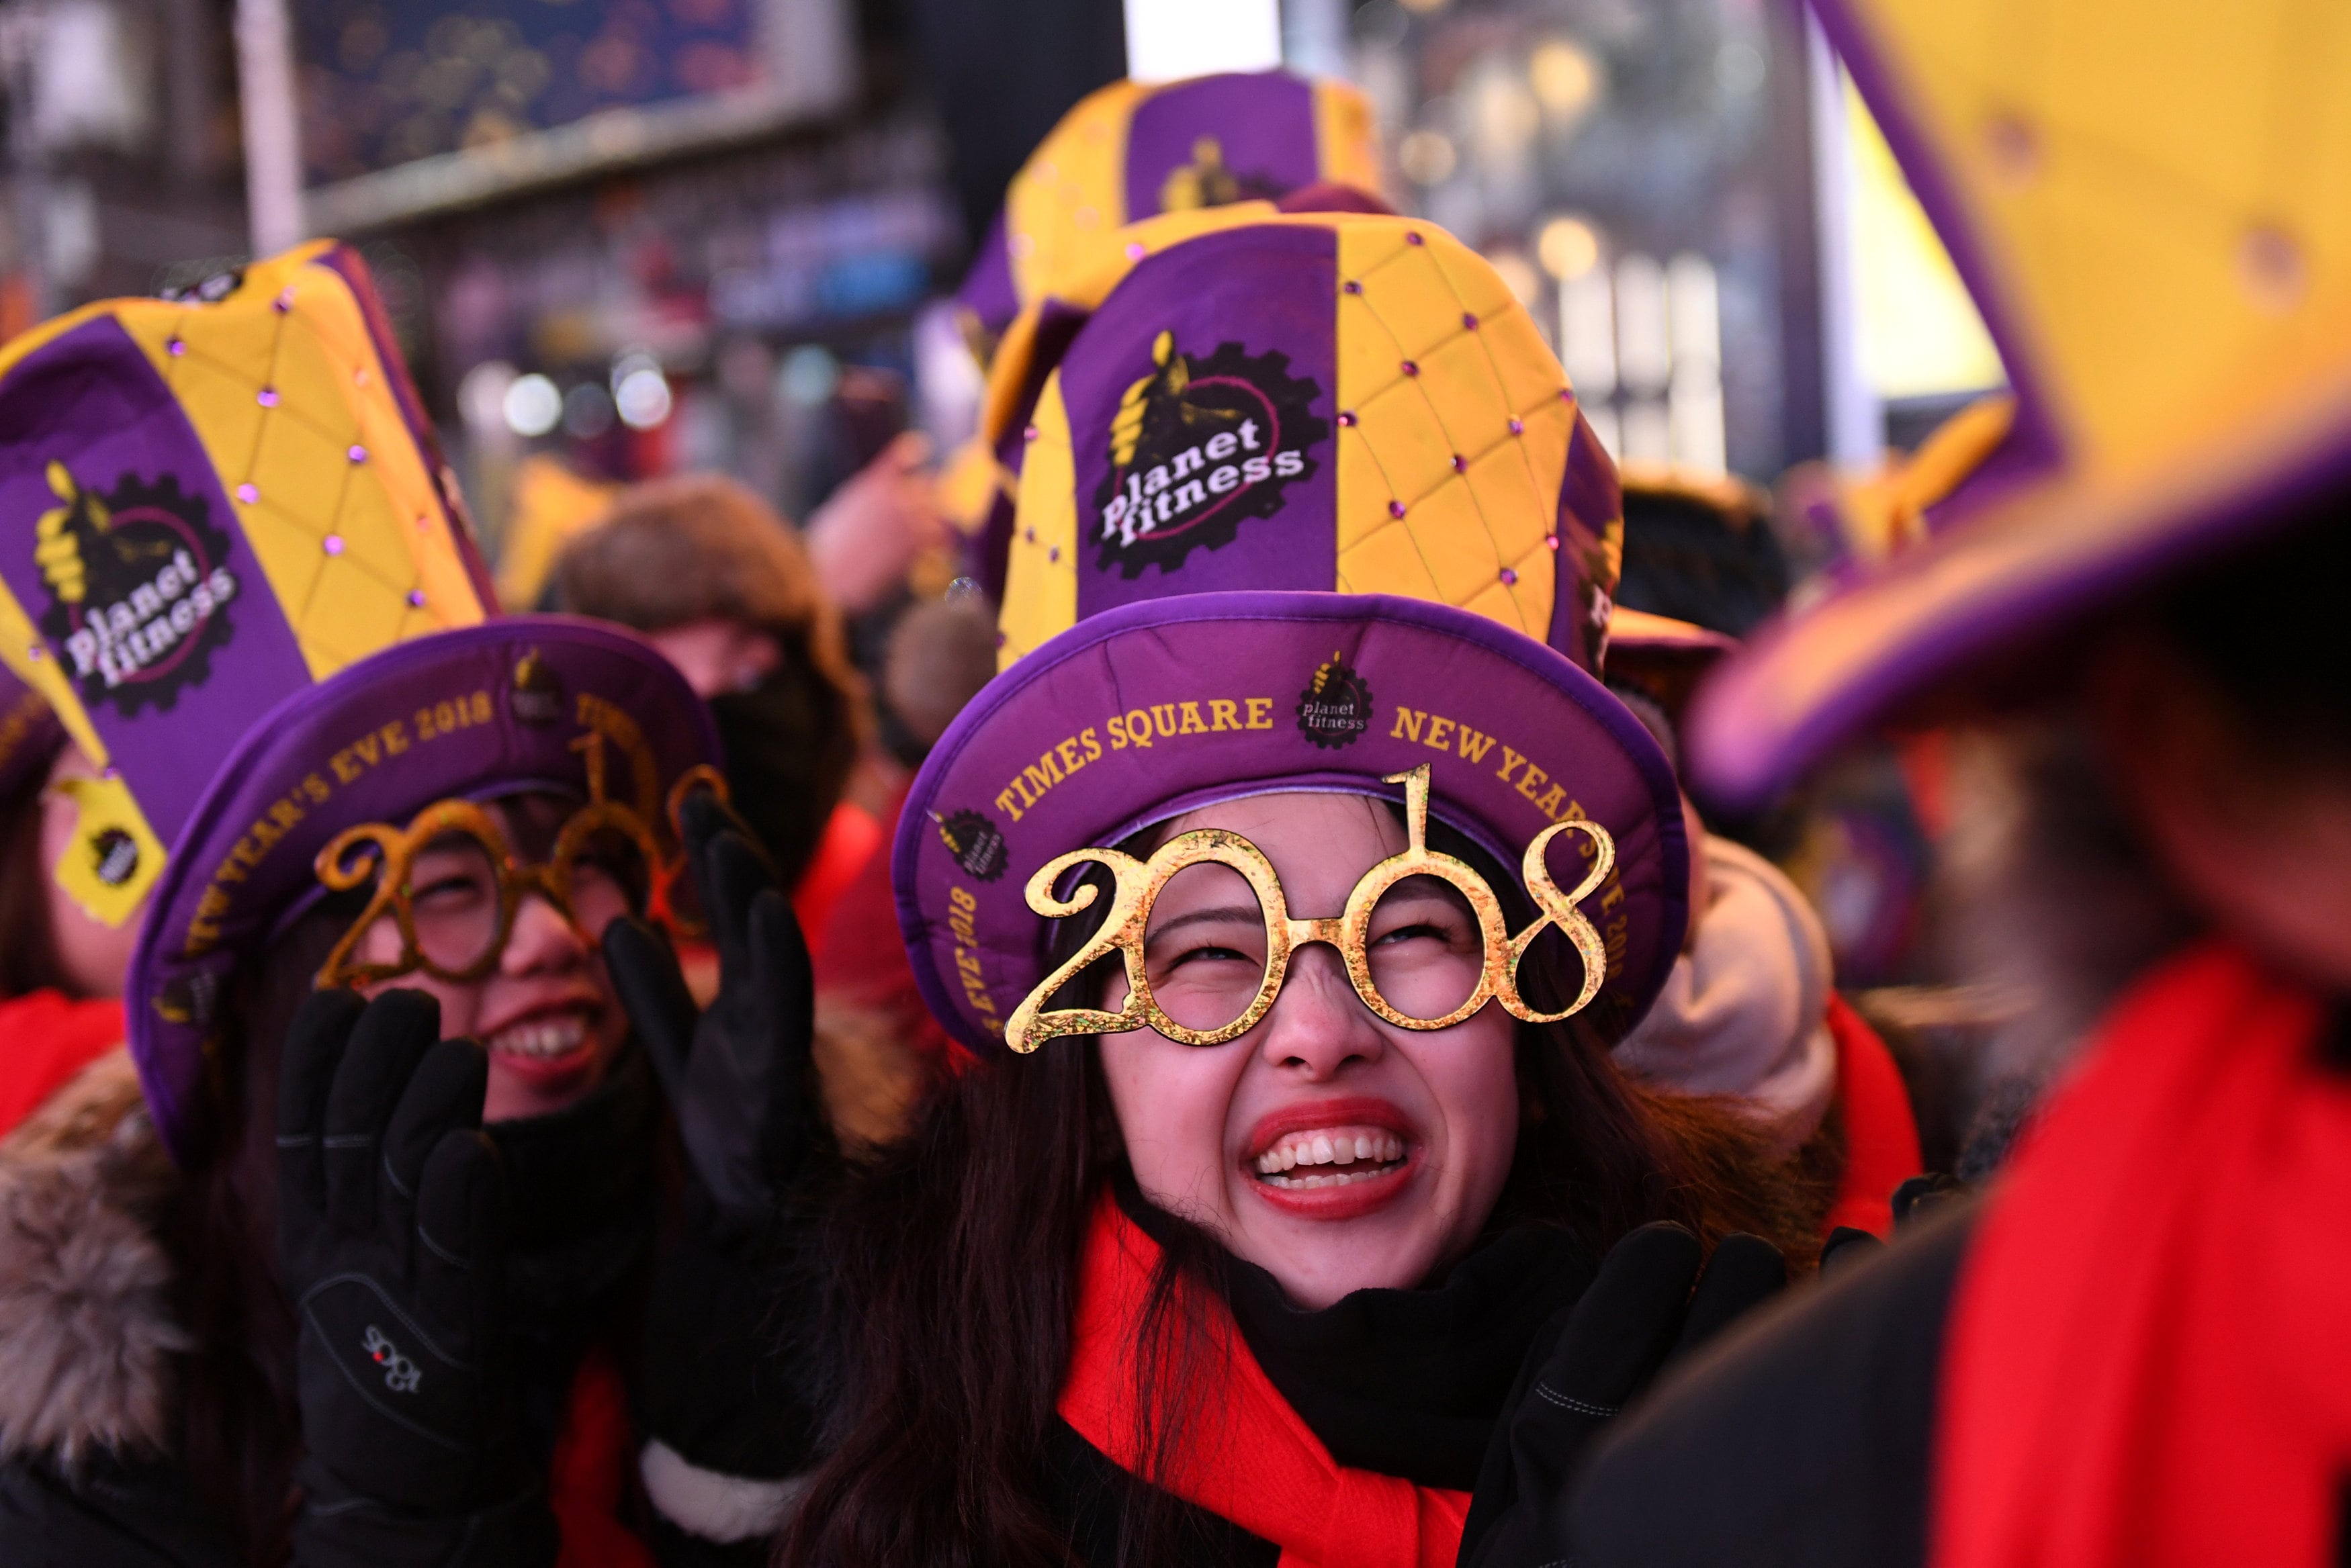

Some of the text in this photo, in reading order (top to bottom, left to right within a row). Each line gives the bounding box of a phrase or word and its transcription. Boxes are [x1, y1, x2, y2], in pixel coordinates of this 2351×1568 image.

[1101, 418, 1261, 540] planet
[1119, 449, 1304, 549] fitness
[64, 546, 197, 678] planet
[96, 566, 236, 689] fitness
[328, 720, 410, 785] EVE
[414, 690, 493, 741] 2018
[994, 697, 1274, 823] TIMES SQUARE
[1302, 701, 1355, 717] planet
[1308, 713, 1365, 730] fitness
[1389, 705, 1497, 764] NEW
[1497, 745, 1599, 858] YEARS
